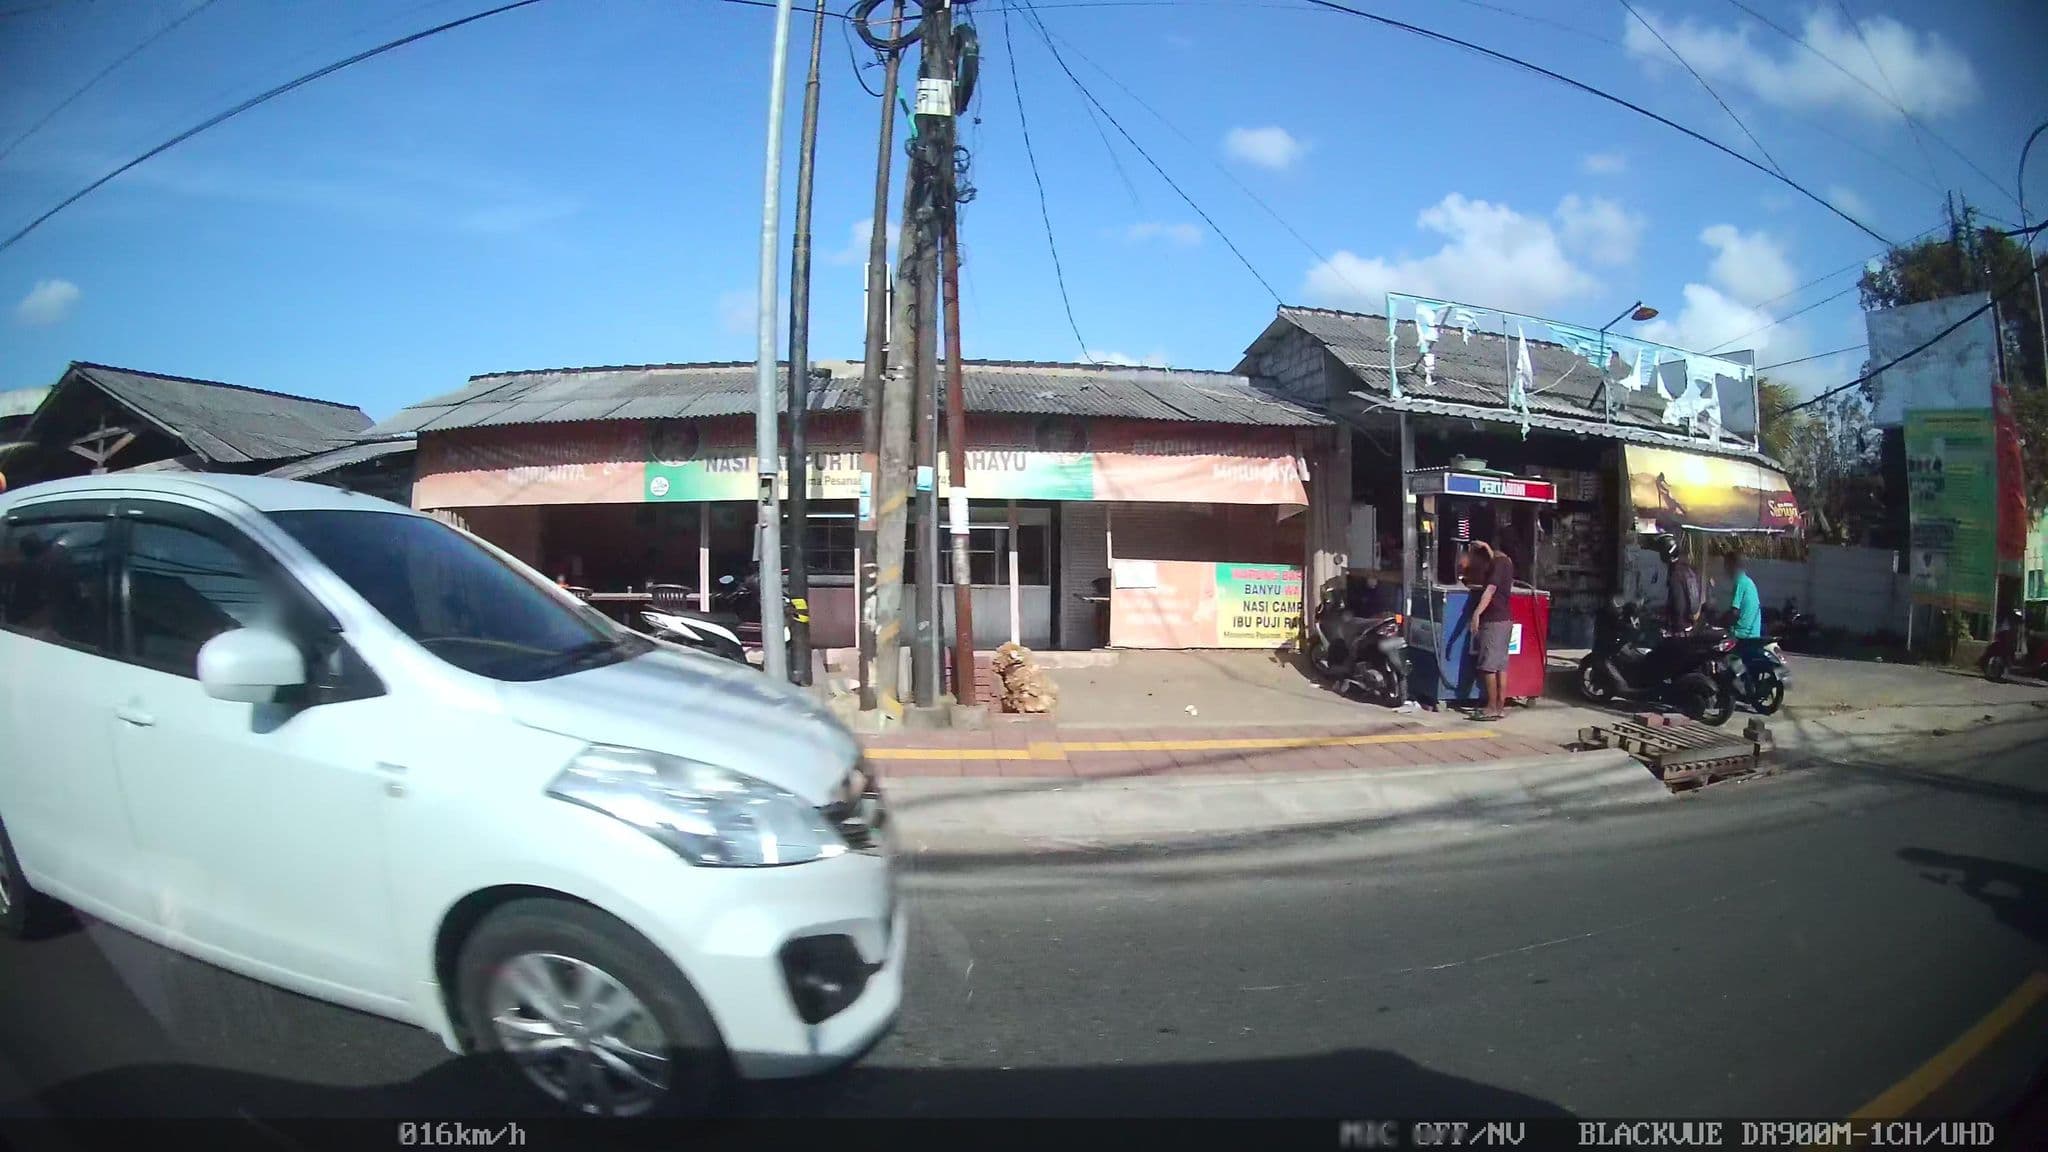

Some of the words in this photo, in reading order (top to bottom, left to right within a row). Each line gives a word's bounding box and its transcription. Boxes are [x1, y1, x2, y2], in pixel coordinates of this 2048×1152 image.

[705, 456, 751, 473] NASI
[1244, 584, 1281, 596] BANYU
[1243, 601, 1268, 613] NASI
[1233, 616, 1252, 628] IBU
[1256, 616, 1280, 628] PUJI
